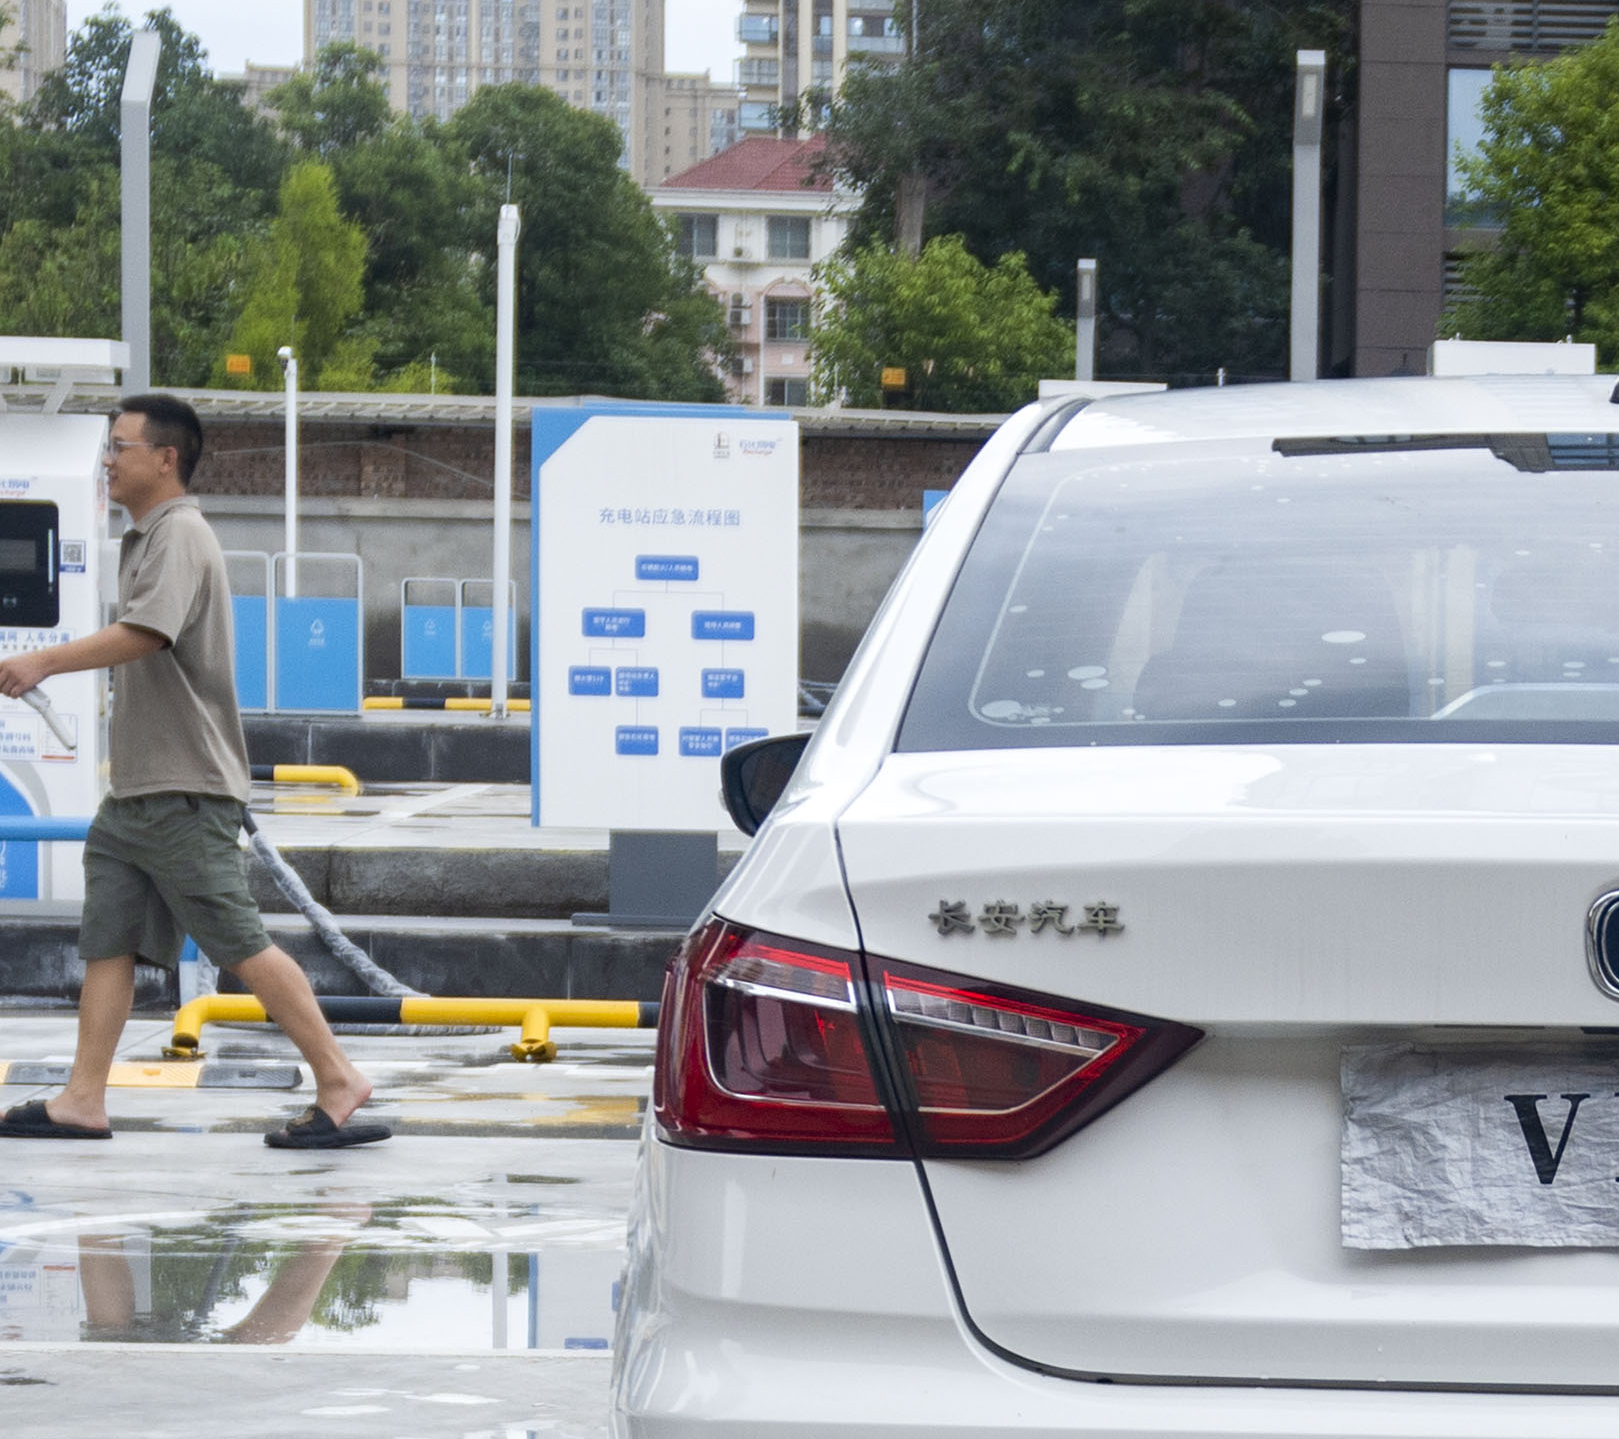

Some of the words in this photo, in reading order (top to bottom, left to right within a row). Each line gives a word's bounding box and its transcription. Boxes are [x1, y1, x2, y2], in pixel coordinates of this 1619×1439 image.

[599, 508, 741, 527] 充电站应急流程图
[928, 899, 1126, 937] 长安汽车
